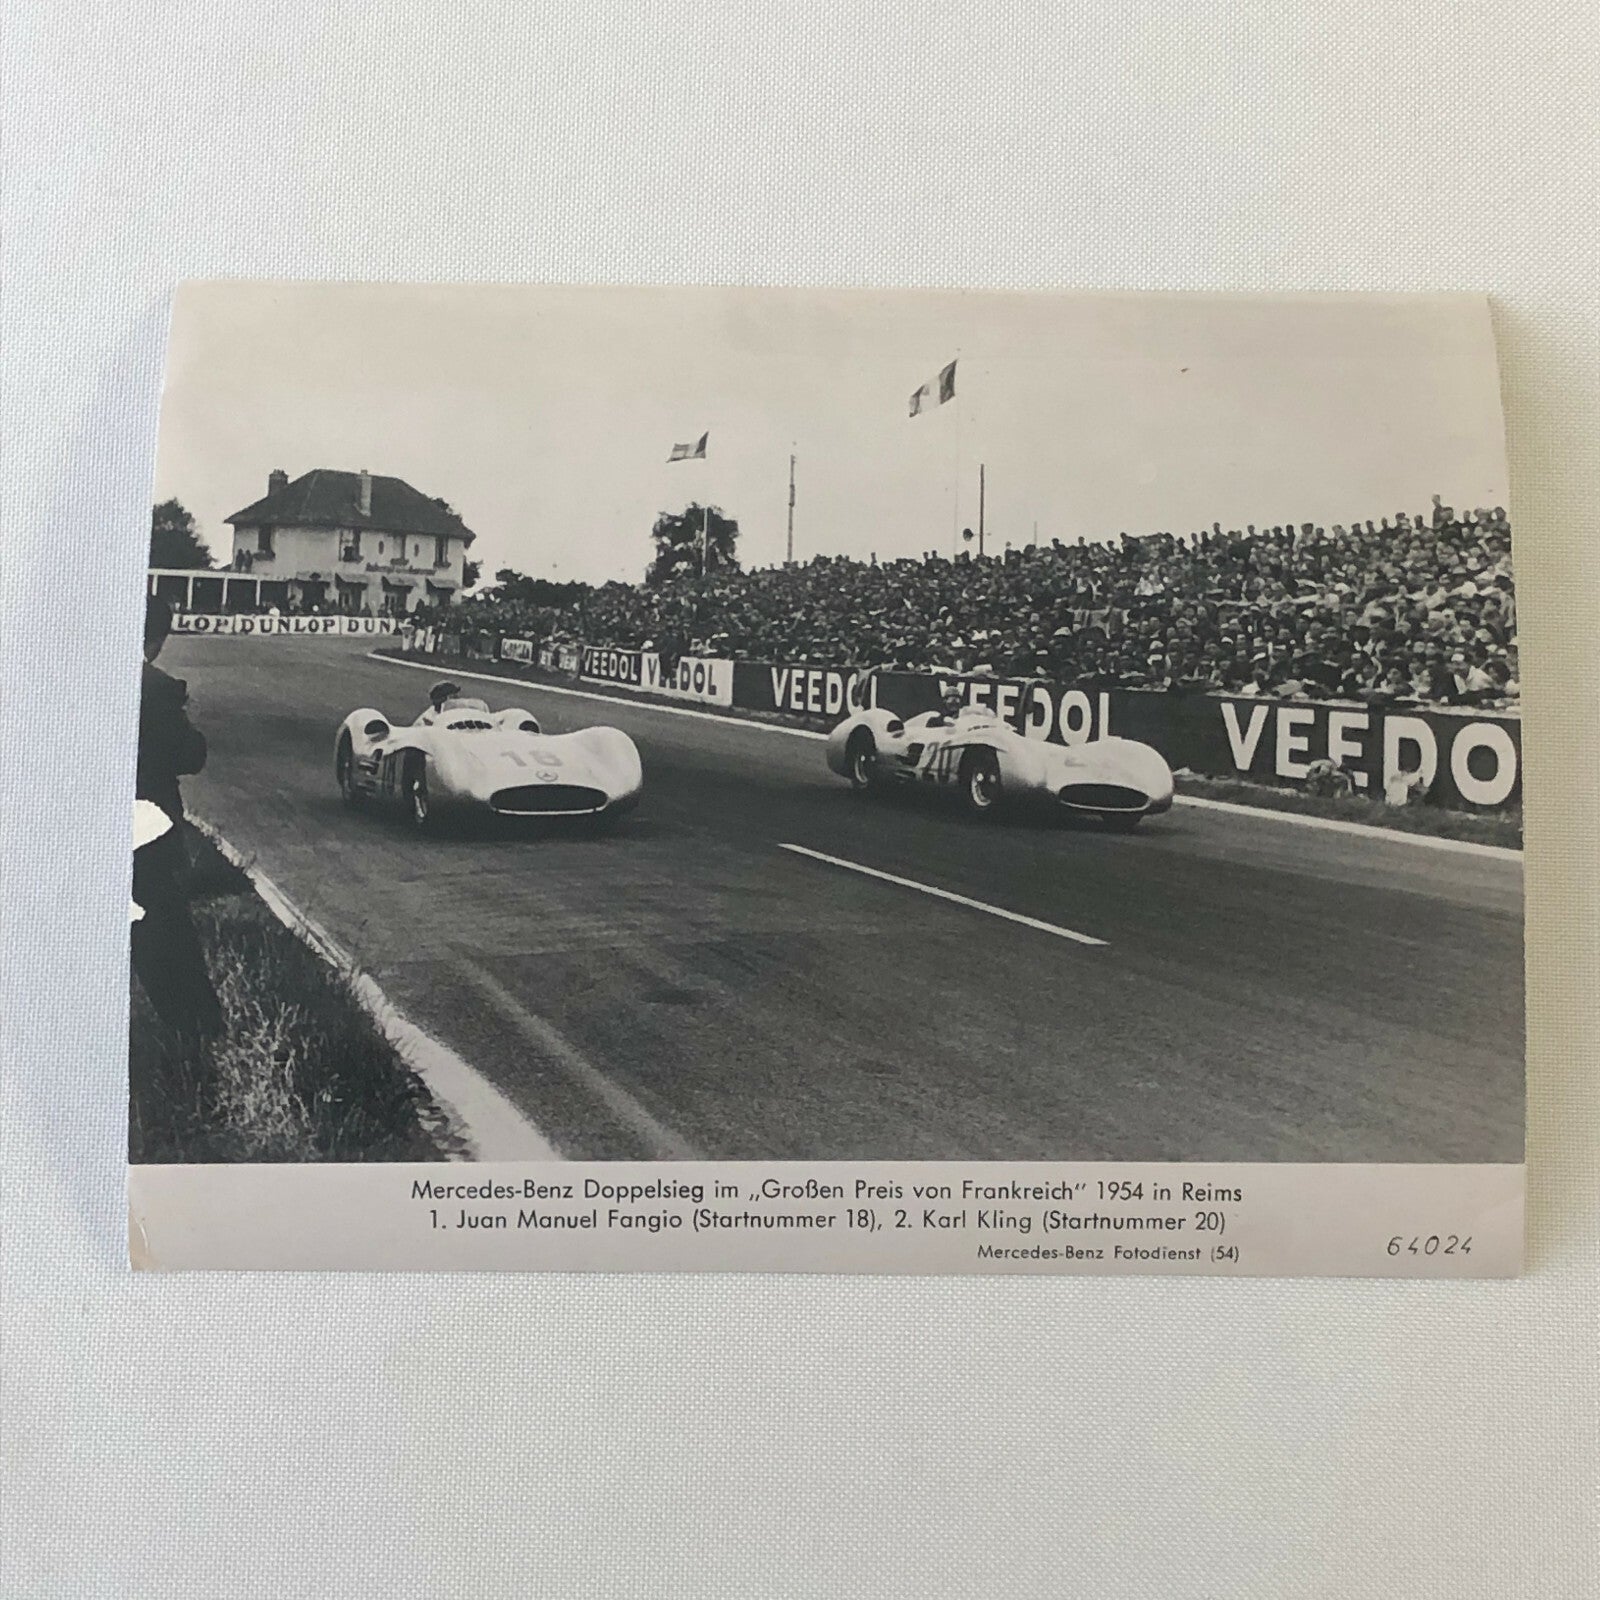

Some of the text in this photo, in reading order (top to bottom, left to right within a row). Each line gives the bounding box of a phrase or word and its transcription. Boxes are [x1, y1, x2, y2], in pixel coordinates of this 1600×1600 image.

[240, 617, 336, 634] DUNLOP
[1220, 702, 1518, 805] VEEDO
[412, 1179, 573, 1199] Mercedes-Benz
[585, 1178, 703, 1204] Doppelsieg
[715, 1180, 738, 1198] im
[856, 1179, 903, 1199] Preis
[913, 1186, 951, 1199] von
[1097, 1181, 1144, 1201] 1954
[1153, 1182, 1171, 1201] in
[1182, 1182, 1242, 1202] Reims
[430, 1209, 1225, 1235] 1. Juan Manuel Fangio (Startnummer 18), 2. Karl Kling (Startnummer 20)
[978, 1244, 1240, 1263] Mercedes-Benz Fotodienst (54)
[1387, 1235, 1472, 1256] 64024
